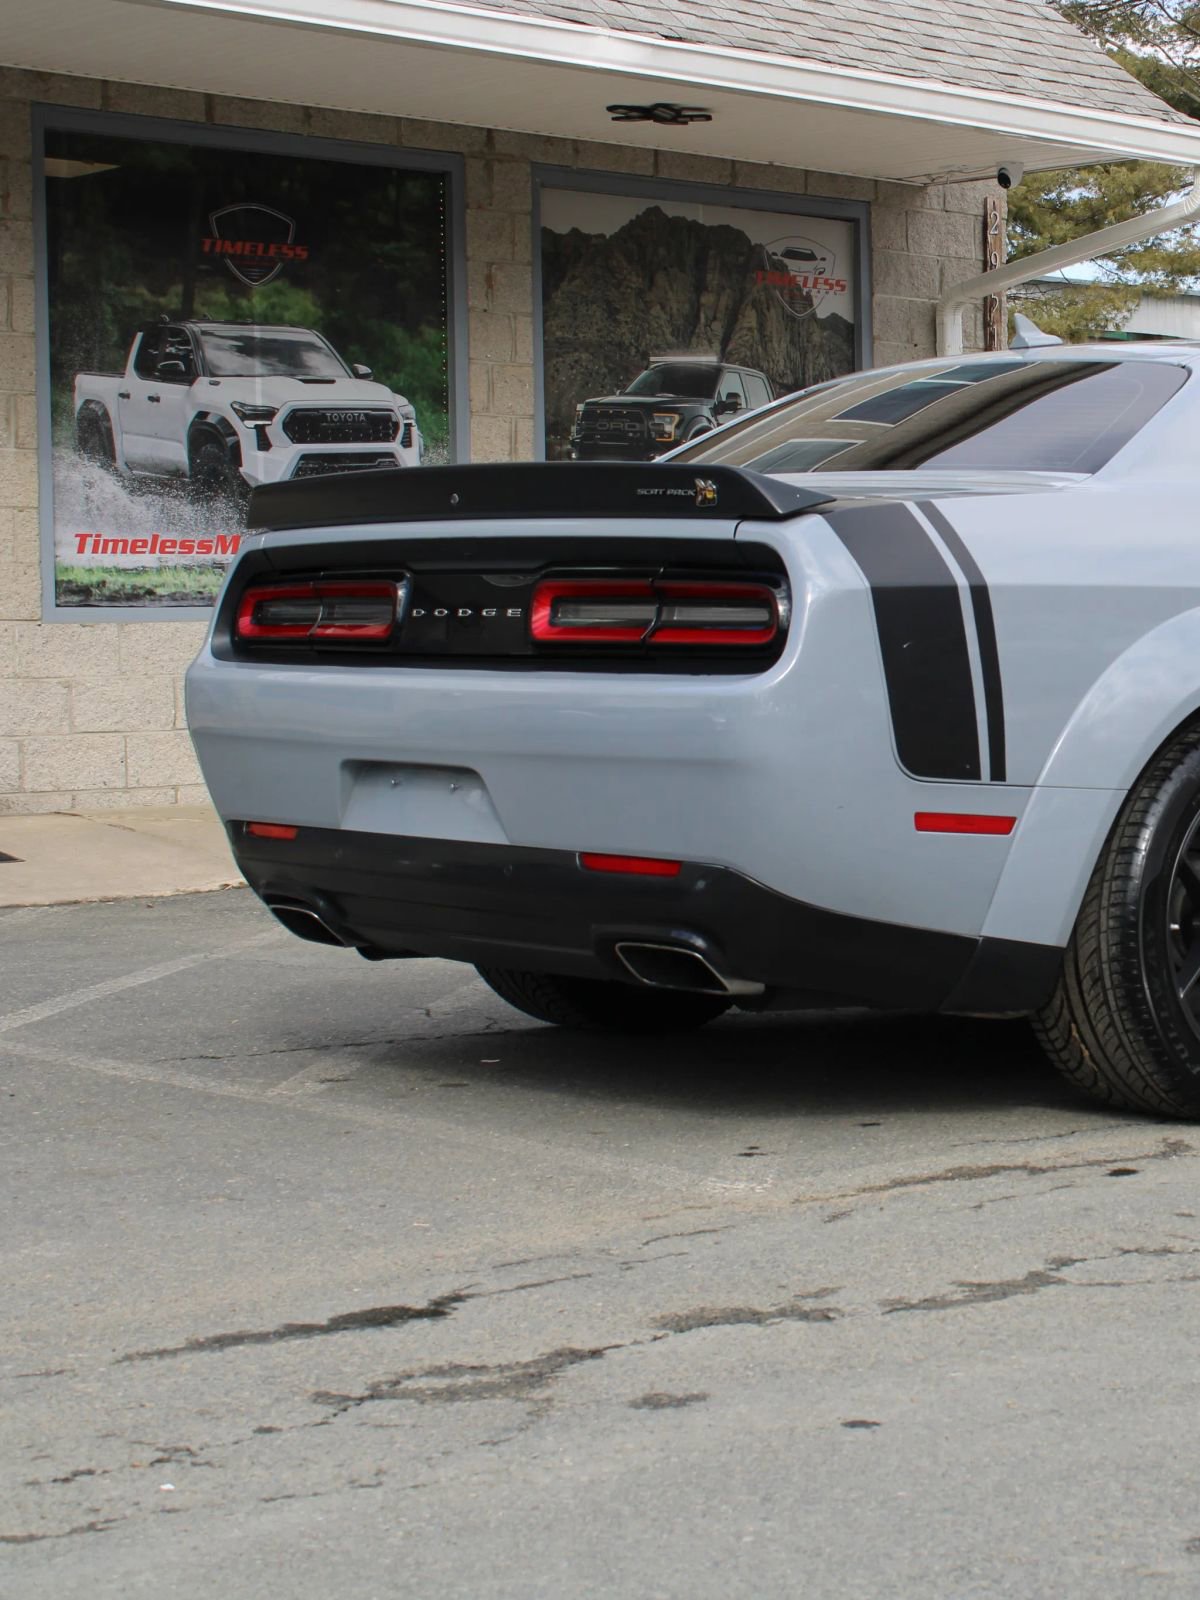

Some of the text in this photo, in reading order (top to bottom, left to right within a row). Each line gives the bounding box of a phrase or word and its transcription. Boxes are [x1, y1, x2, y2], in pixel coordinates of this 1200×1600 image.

[202, 238, 309, 259] TIMELESS
[326, 413, 366, 422] TOYOTA
[666, 488, 696, 496] PACK
[412, 608, 522, 617] DODGE
